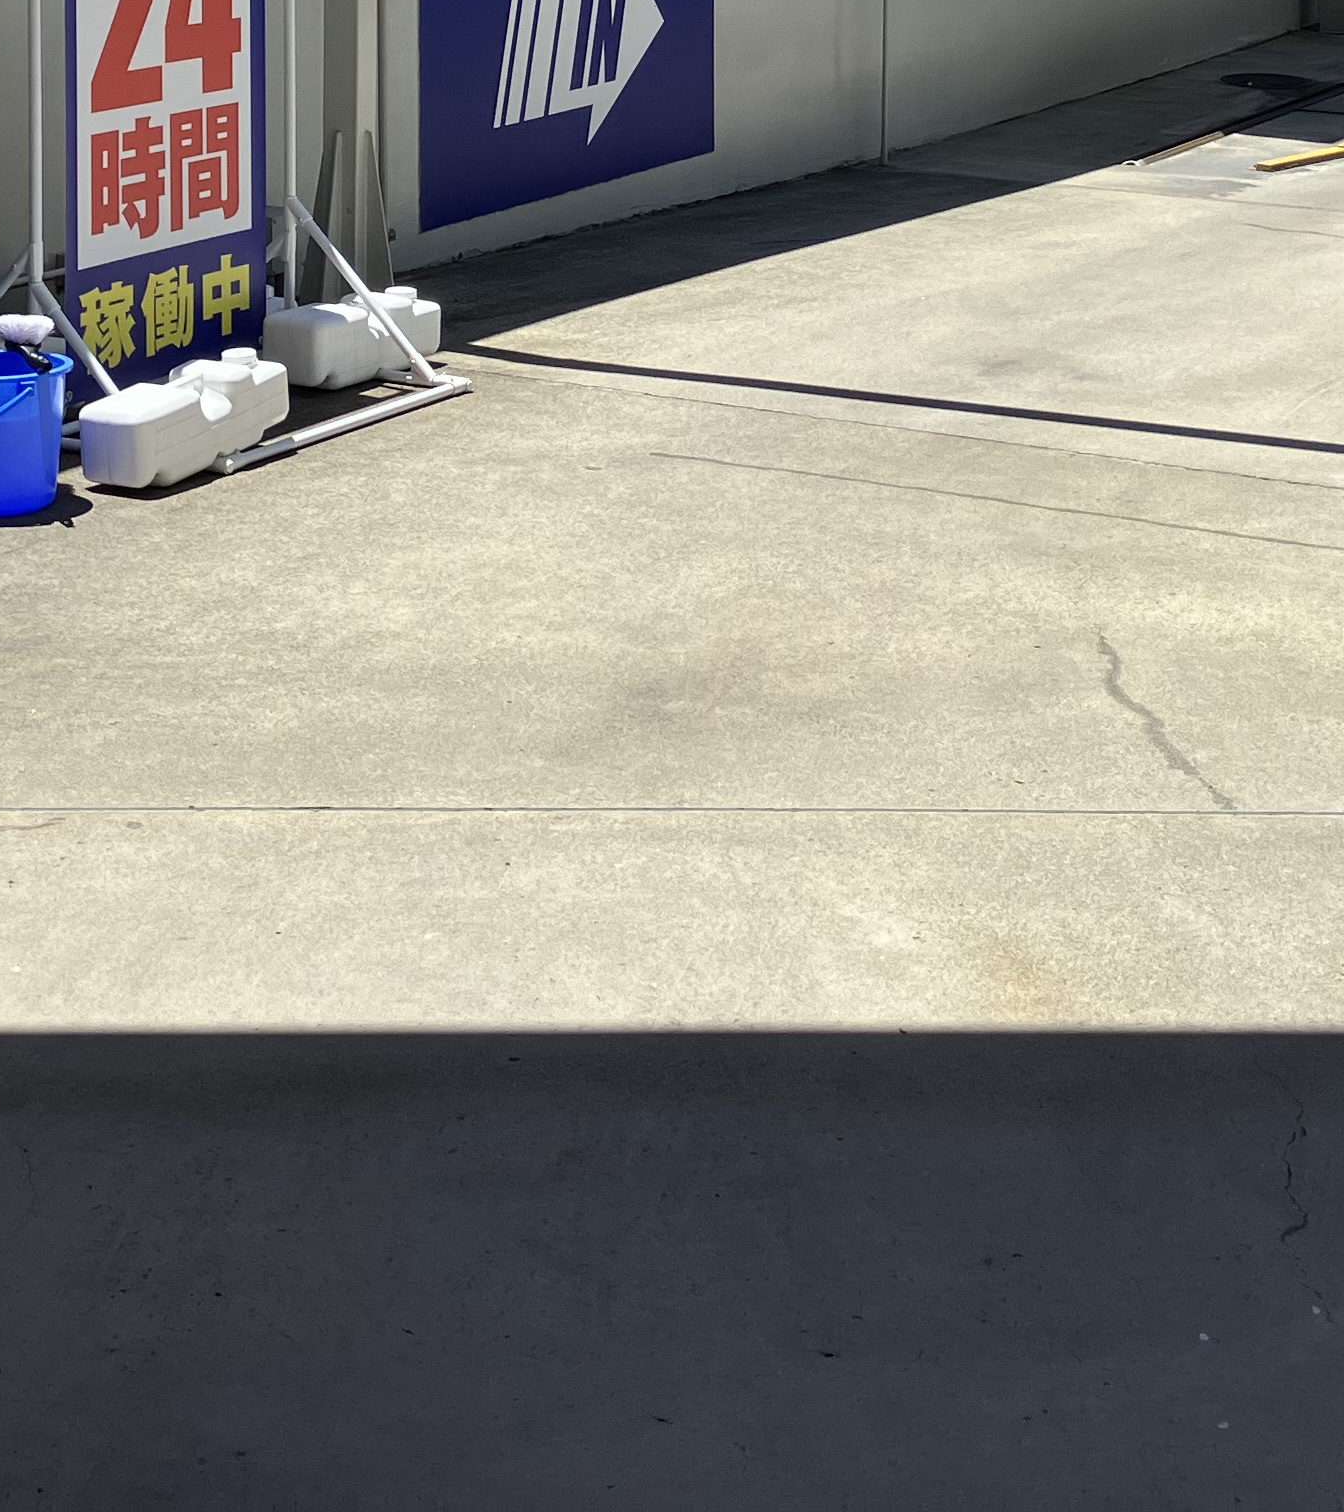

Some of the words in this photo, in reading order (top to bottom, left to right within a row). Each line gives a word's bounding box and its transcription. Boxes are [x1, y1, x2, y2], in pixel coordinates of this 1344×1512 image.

[91, 102, 239, 239] 時間
[78, 254, 251, 376] 稼働中
